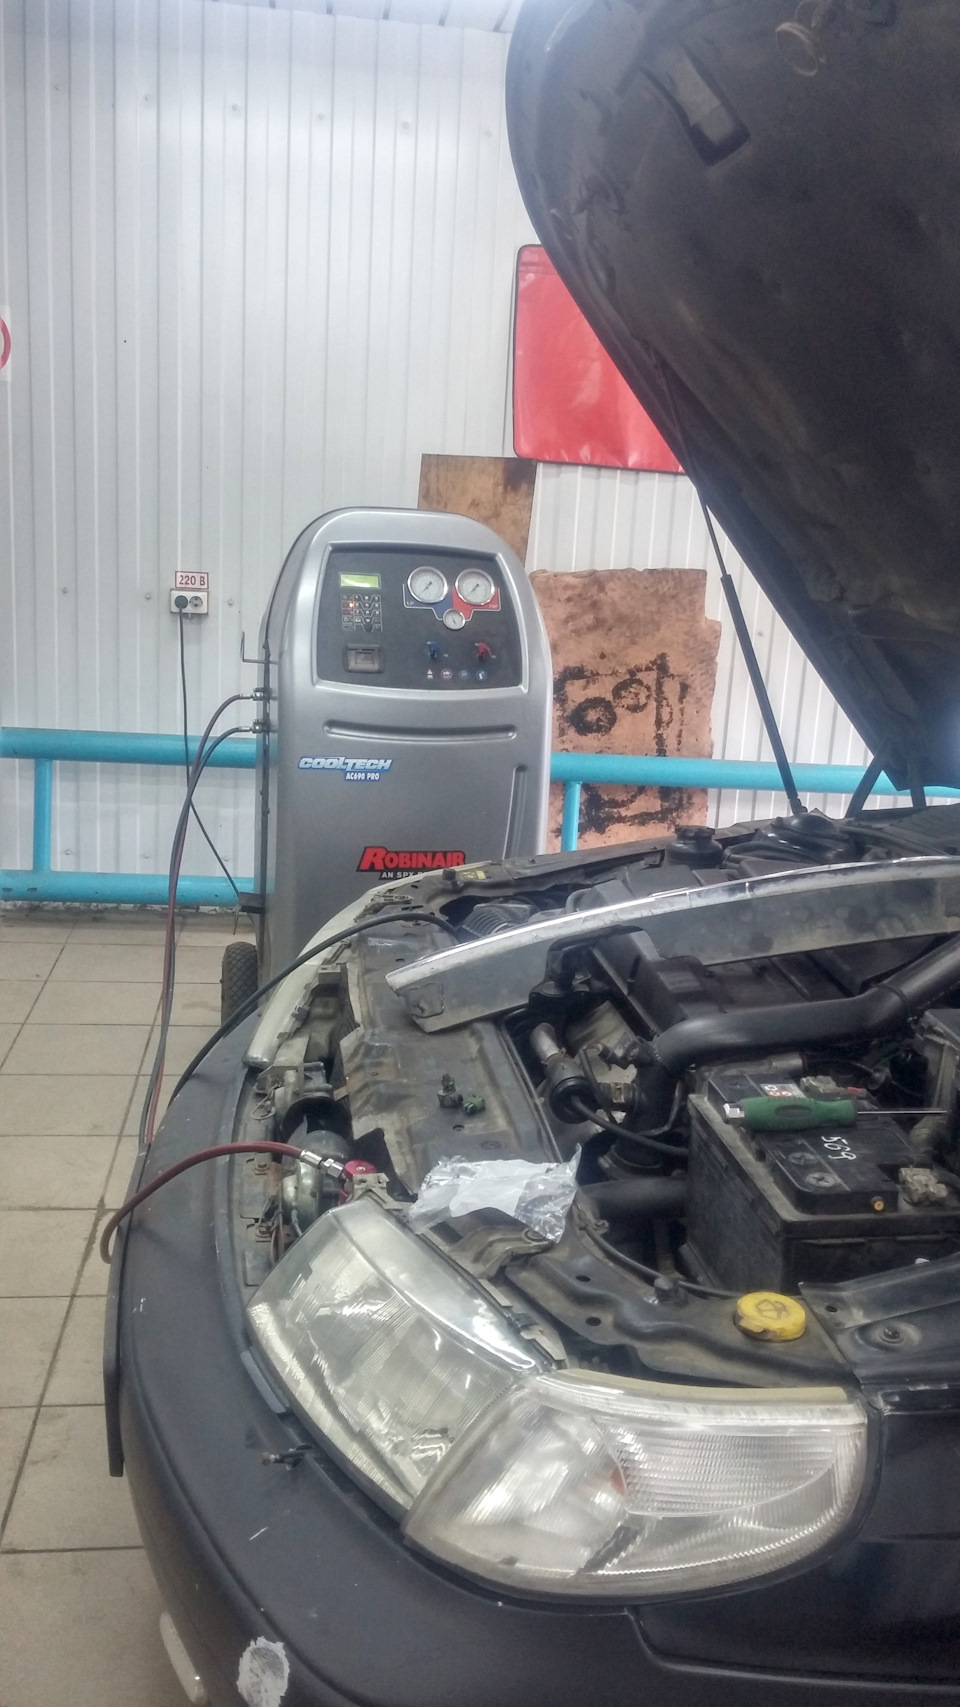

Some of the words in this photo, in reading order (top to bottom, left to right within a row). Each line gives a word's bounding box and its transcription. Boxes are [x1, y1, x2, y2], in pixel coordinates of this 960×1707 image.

[179, 575, 196, 585] 220
[299, 757, 392, 771] COOLTECH
[346, 772, 366, 780] AC690
[359, 847, 465, 869] ROBINAIR
[821, 1136, 857, 1160] 569
